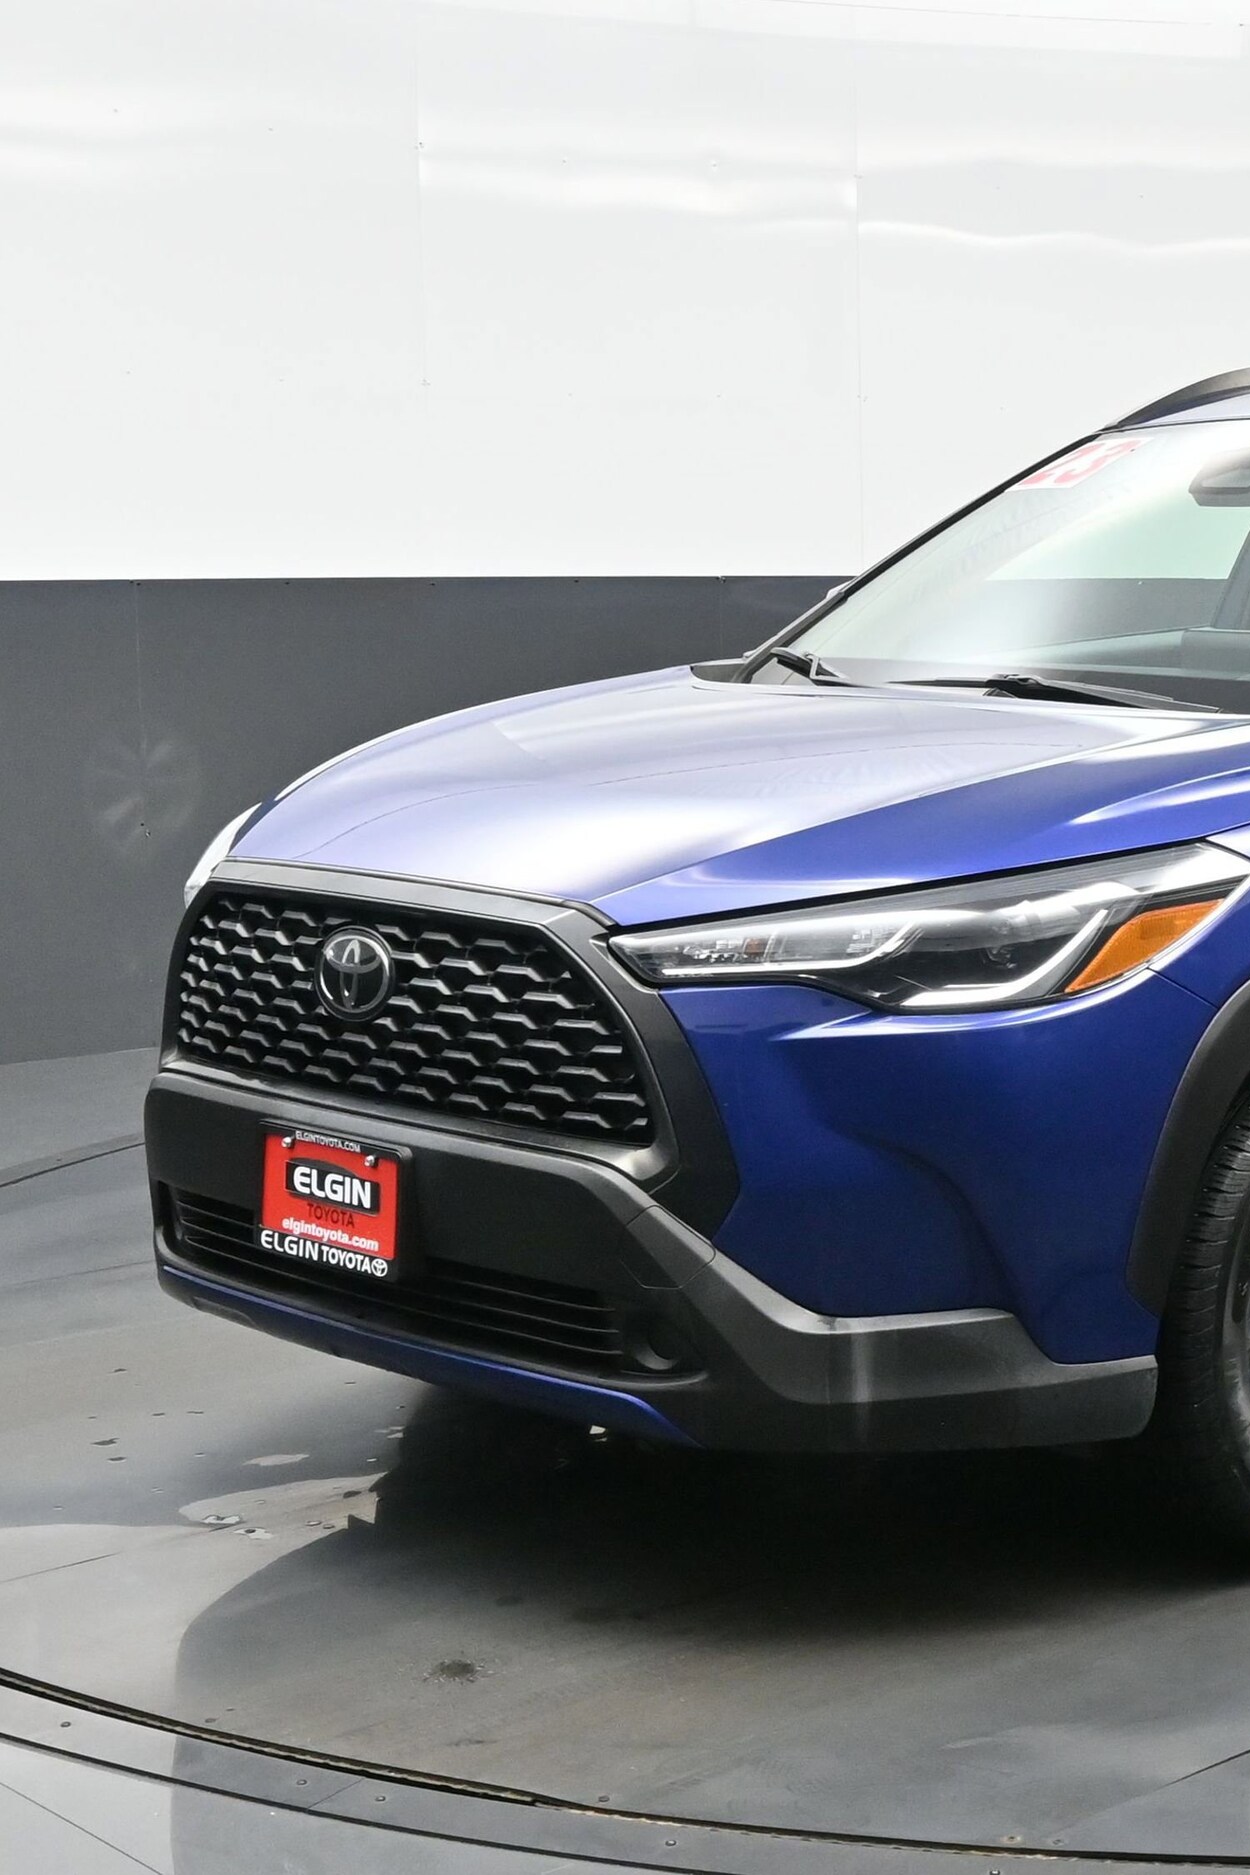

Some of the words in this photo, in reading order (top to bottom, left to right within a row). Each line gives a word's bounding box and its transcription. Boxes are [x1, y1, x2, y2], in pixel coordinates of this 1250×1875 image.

[295, 1130, 361, 1153] ELGINTOYOTA.COM
[293, 1166, 371, 1209] ELGIN
[307, 1203, 355, 1228] TOYOTA
[282, 1217, 379, 1251] elgintoyota.com
[260, 1230, 319, 1261] ELGIN
[321, 1245, 371, 1274] TOYOTA
